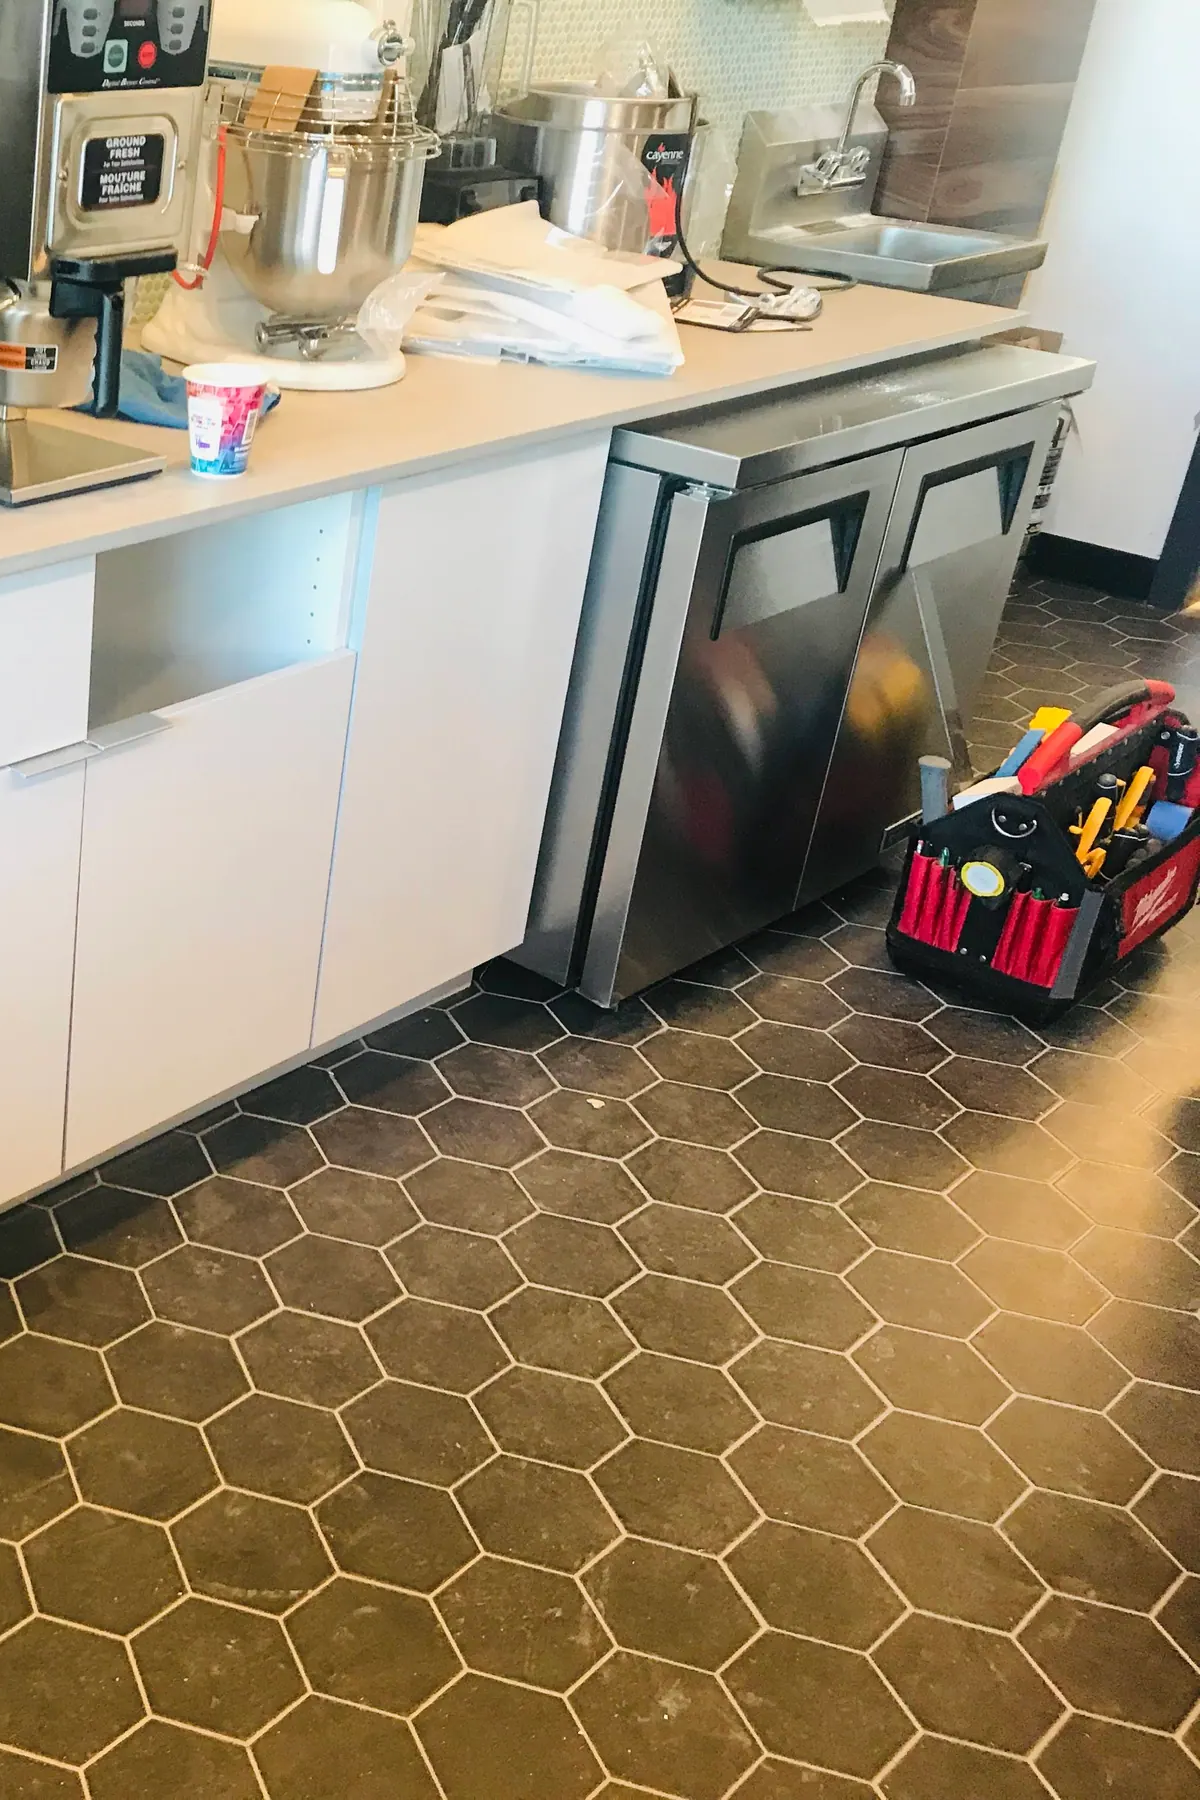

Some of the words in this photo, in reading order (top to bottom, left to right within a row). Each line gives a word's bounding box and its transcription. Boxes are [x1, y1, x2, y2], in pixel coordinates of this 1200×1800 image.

[105, 135, 147, 149] GROUND
[109, 147, 141, 159] FRESH
[646, 150, 684, 163] cayenne
[99, 170, 147, 184] MOUTURE
